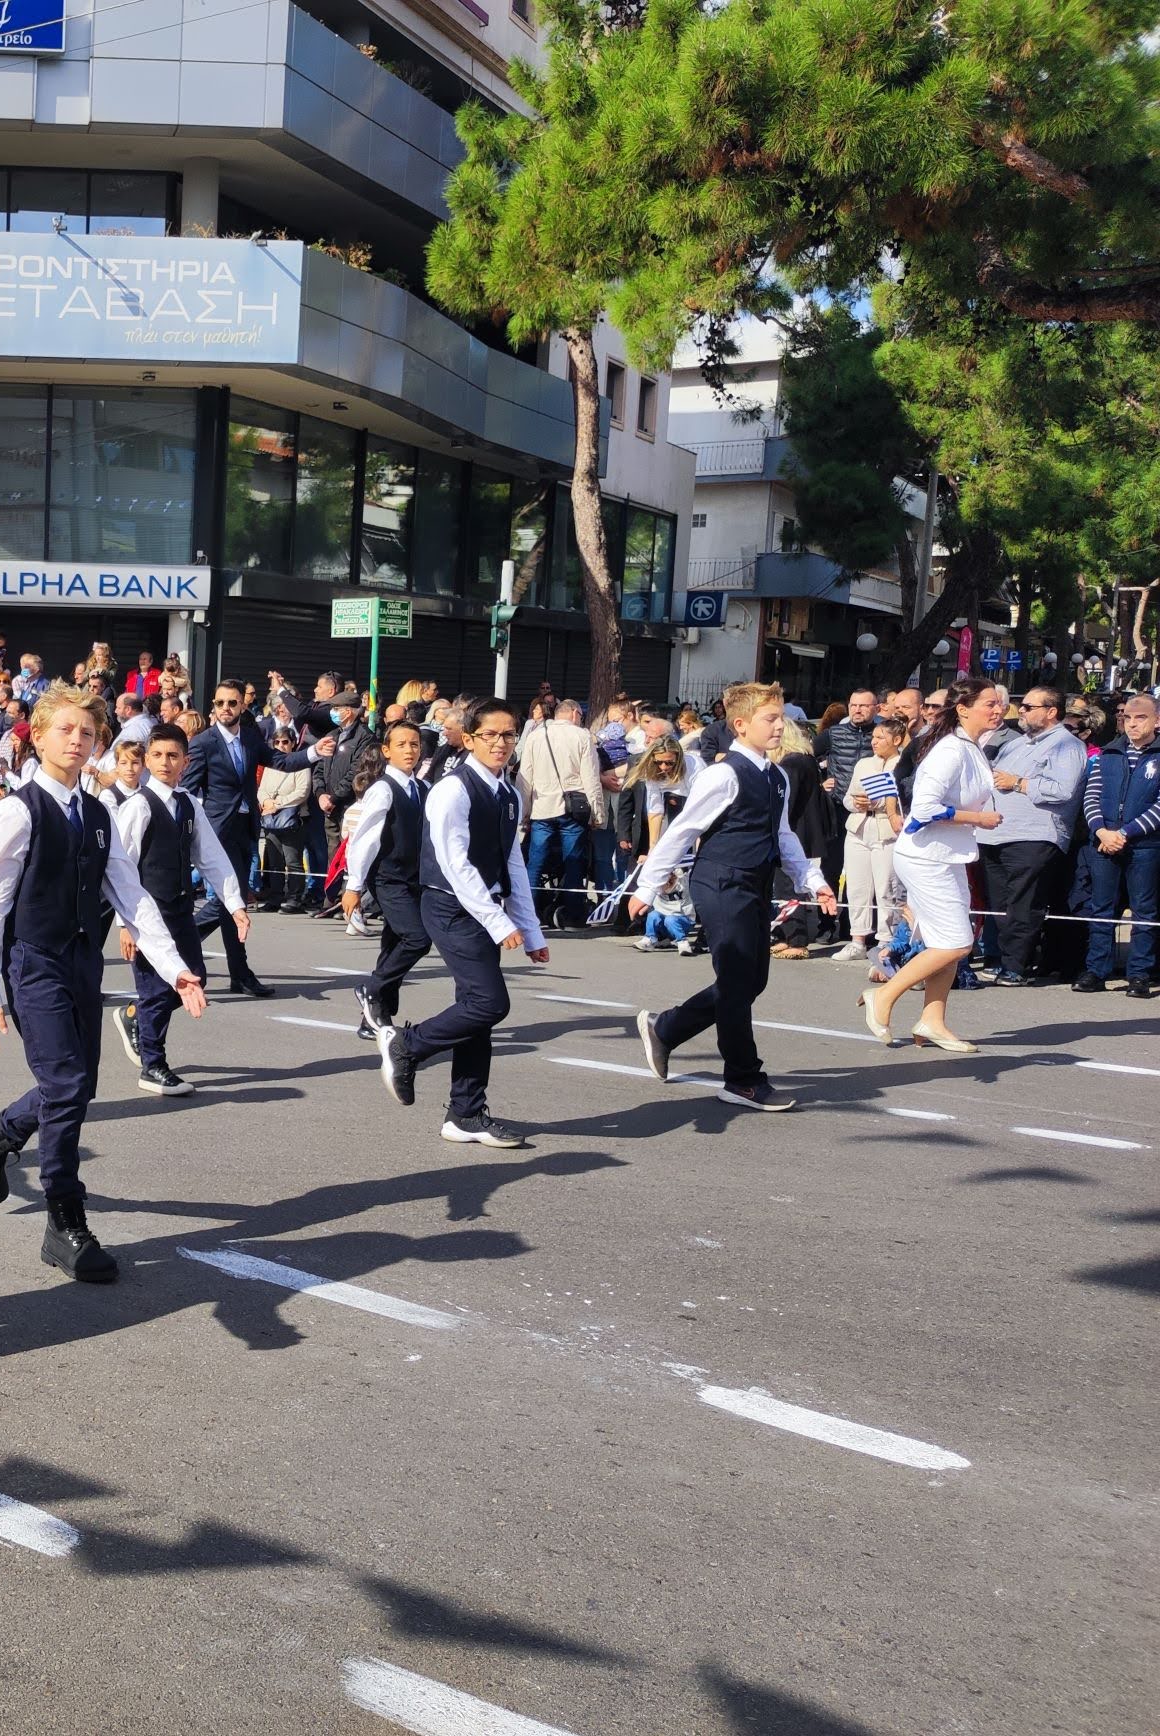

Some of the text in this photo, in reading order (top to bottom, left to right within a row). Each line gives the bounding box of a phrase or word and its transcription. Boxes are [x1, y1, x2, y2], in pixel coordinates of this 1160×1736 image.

[98, 573, 199, 600] BANK
[987, 649, 997, 659] P
[1009, 651, 1019, 660] P
